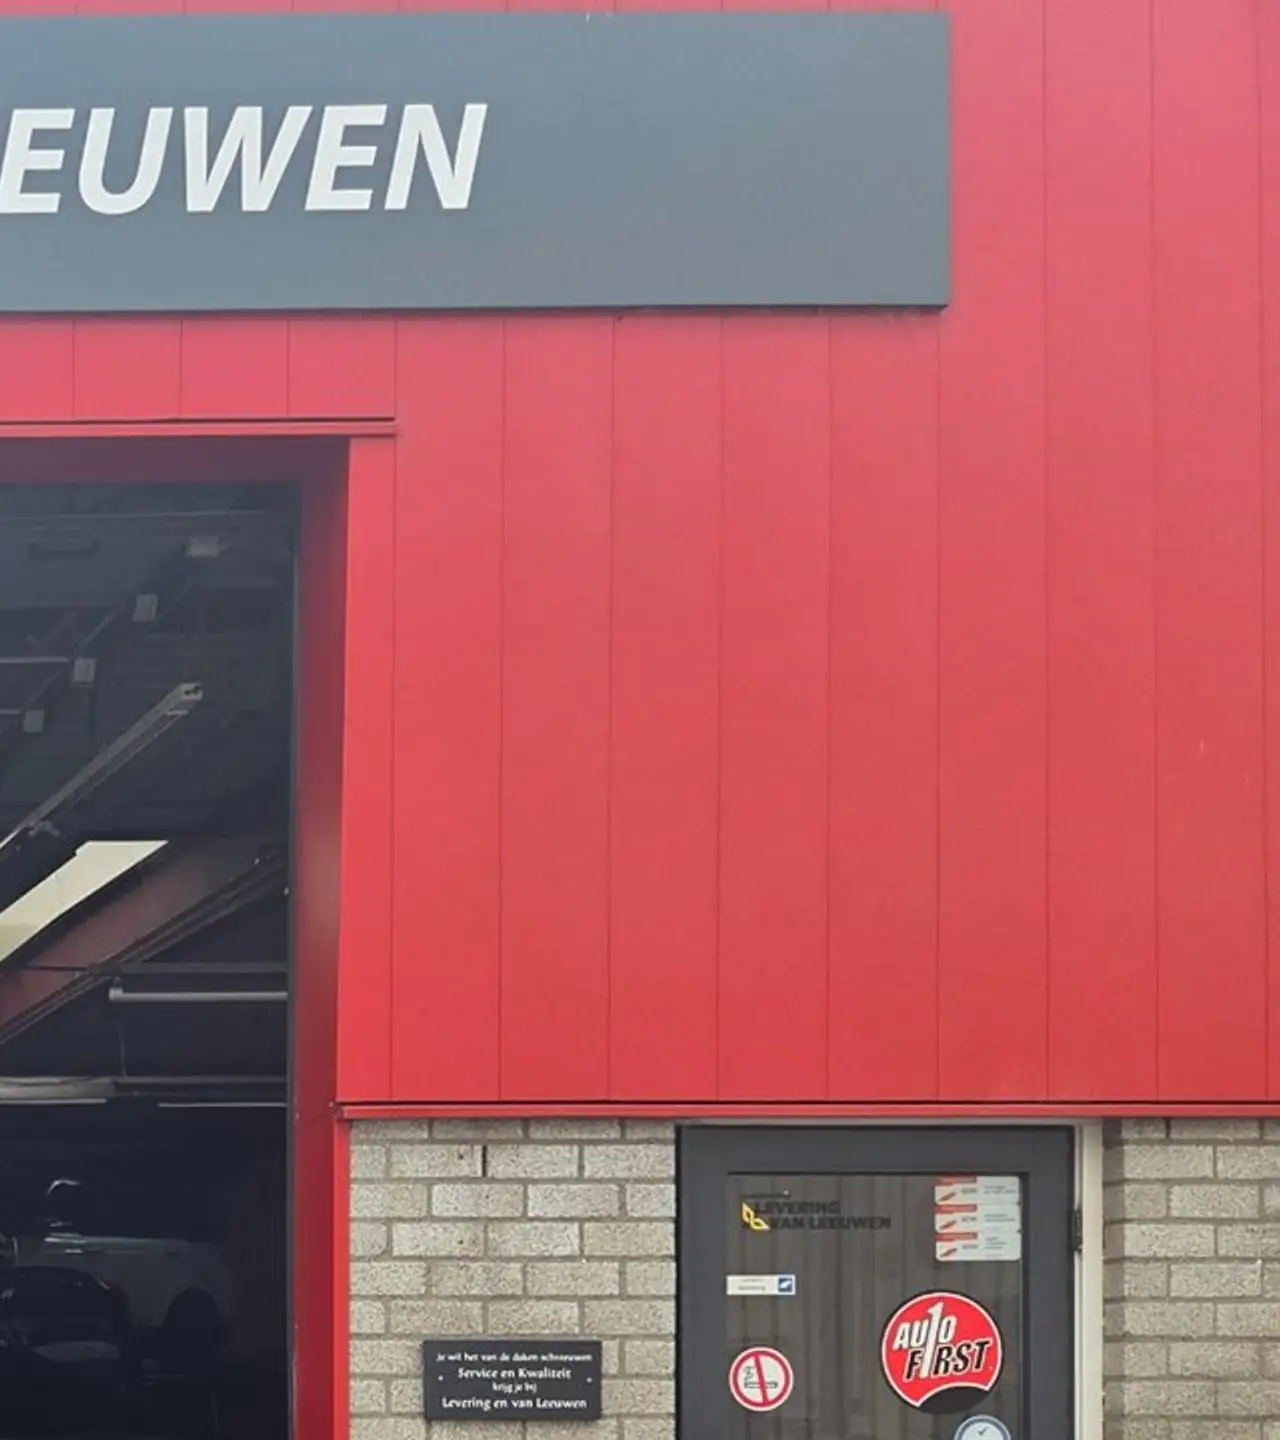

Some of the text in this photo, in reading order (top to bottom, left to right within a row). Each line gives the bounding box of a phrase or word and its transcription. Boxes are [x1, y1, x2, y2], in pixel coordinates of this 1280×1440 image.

[458, 1367, 571, 1379] Service en Kwaliteit
[442, 1397, 587, 1411] Levering en van Leeuwen
